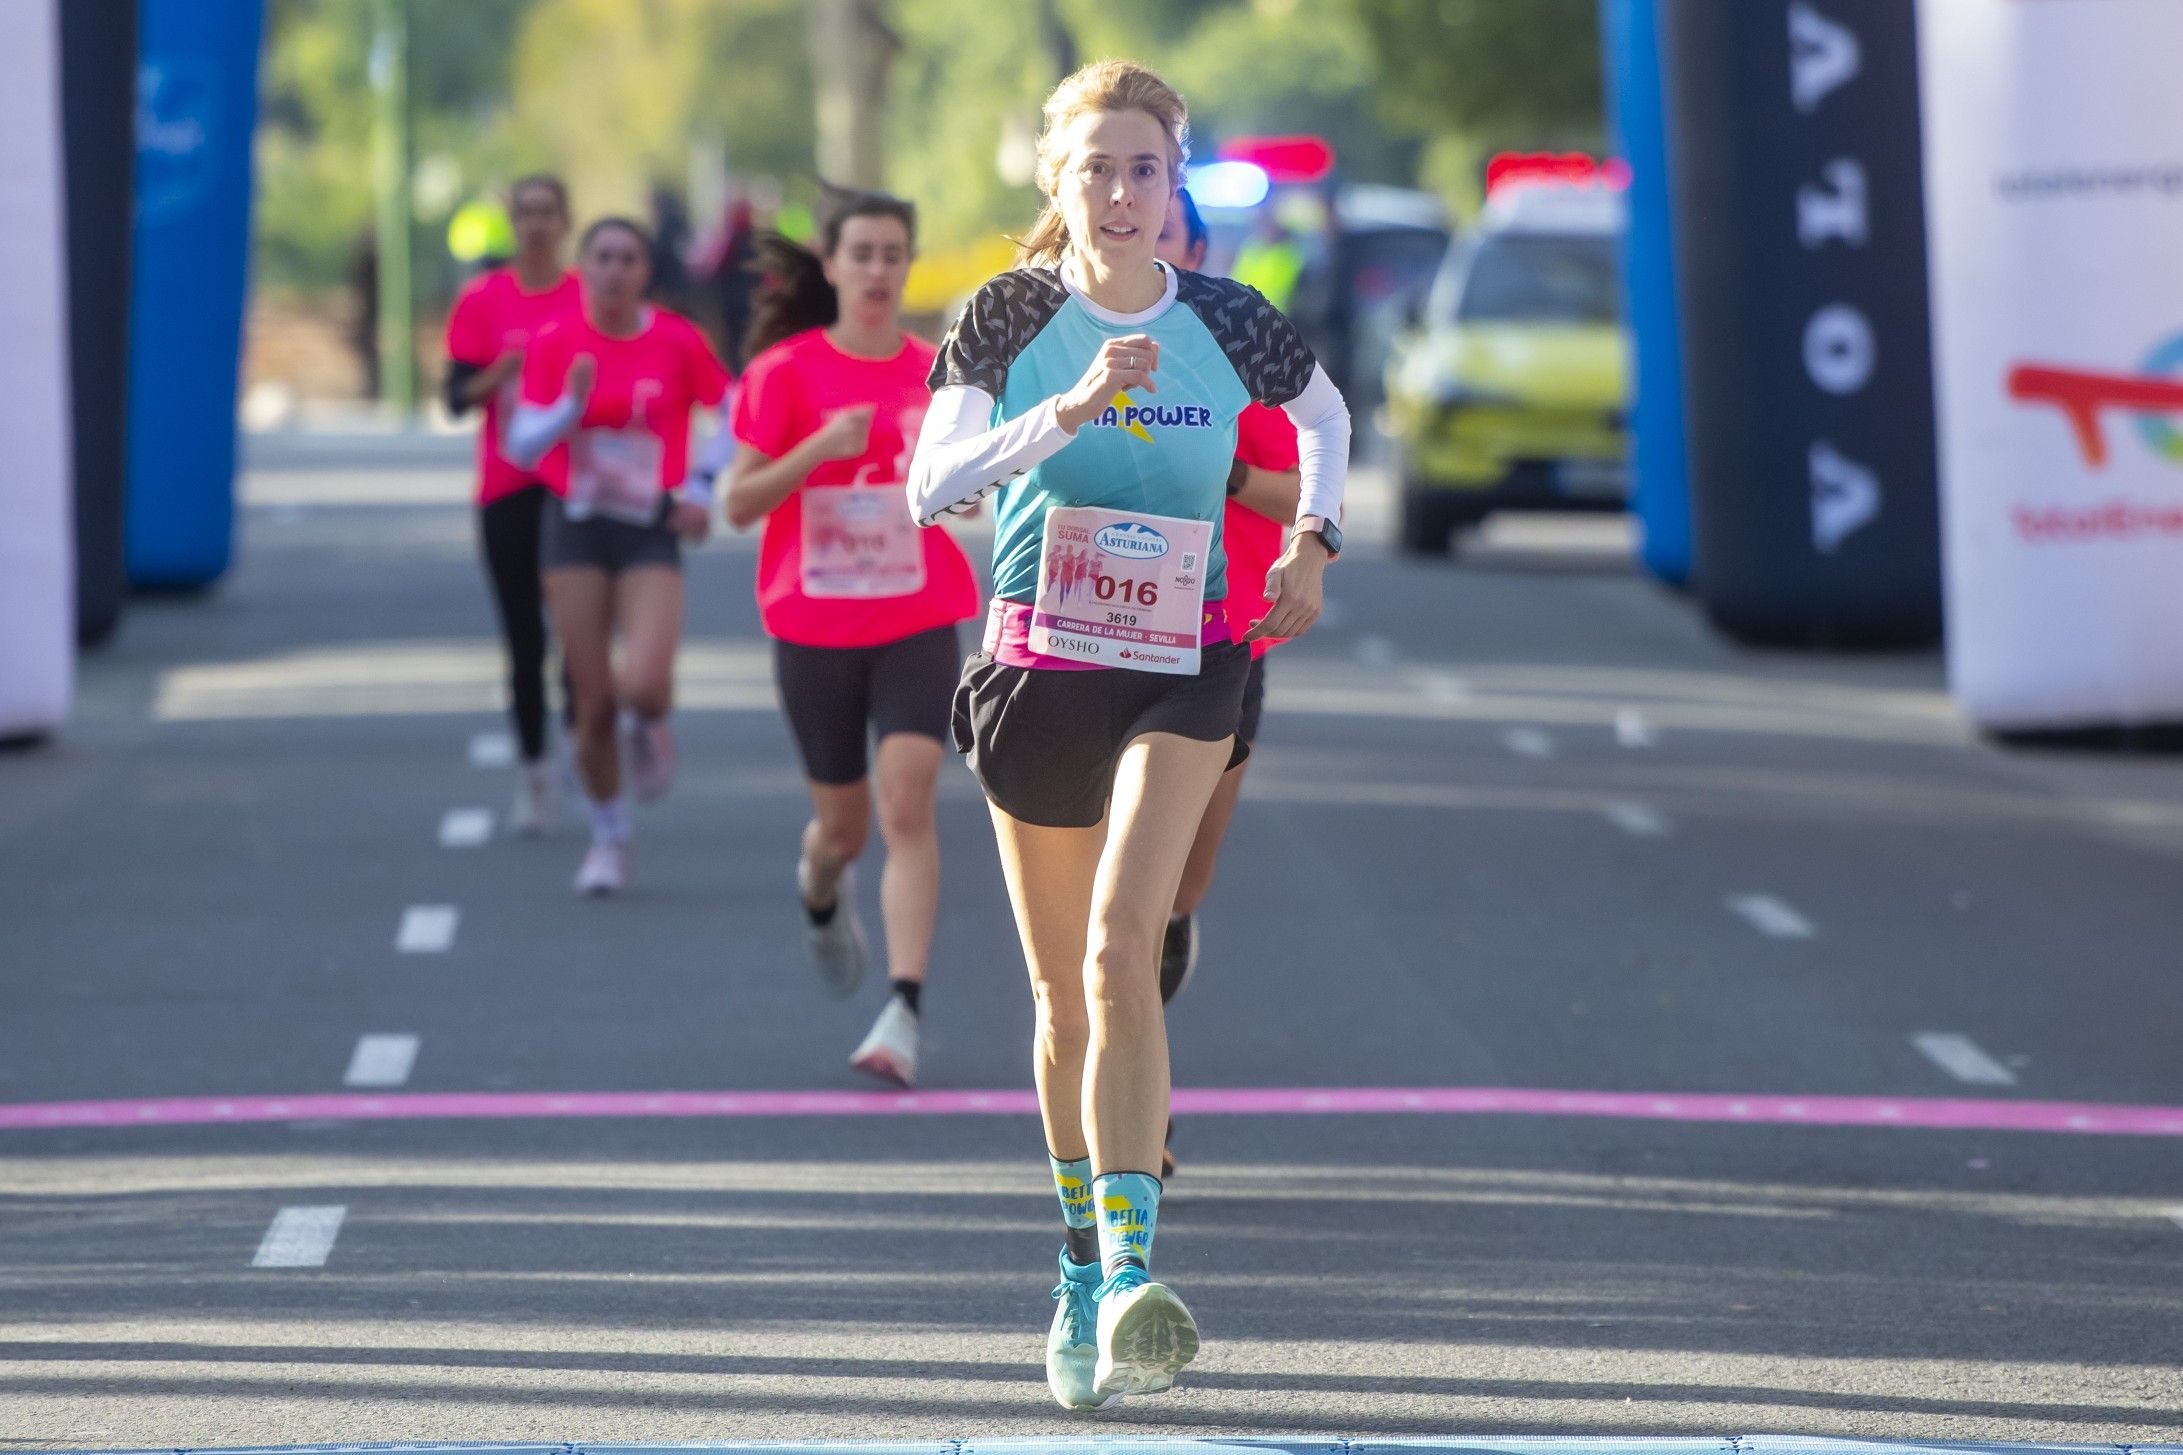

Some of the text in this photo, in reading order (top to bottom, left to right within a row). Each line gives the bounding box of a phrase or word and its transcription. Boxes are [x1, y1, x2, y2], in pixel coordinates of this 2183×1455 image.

[1787, 2, 1882, 553] VOLV
[1125, 405, 1212, 427] POWER
[1057, 530, 1089, 543] SUMA
[1095, 575, 1158, 606] 016
[1106, 612, 1137, 626] 3619
[1056, 619, 1090, 633] CARRERA
[1092, 626, 1102, 634] DE
[1104, 628, 1114, 636] LA
[1116, 630, 1143, 641] MUJER
[1149, 633, 1176, 644] SEVILLA
[1048, 635, 1100, 655] OYSHO
[1132, 650, 1180, 665] Santander
[1062, 1183, 1092, 1199] BETT
